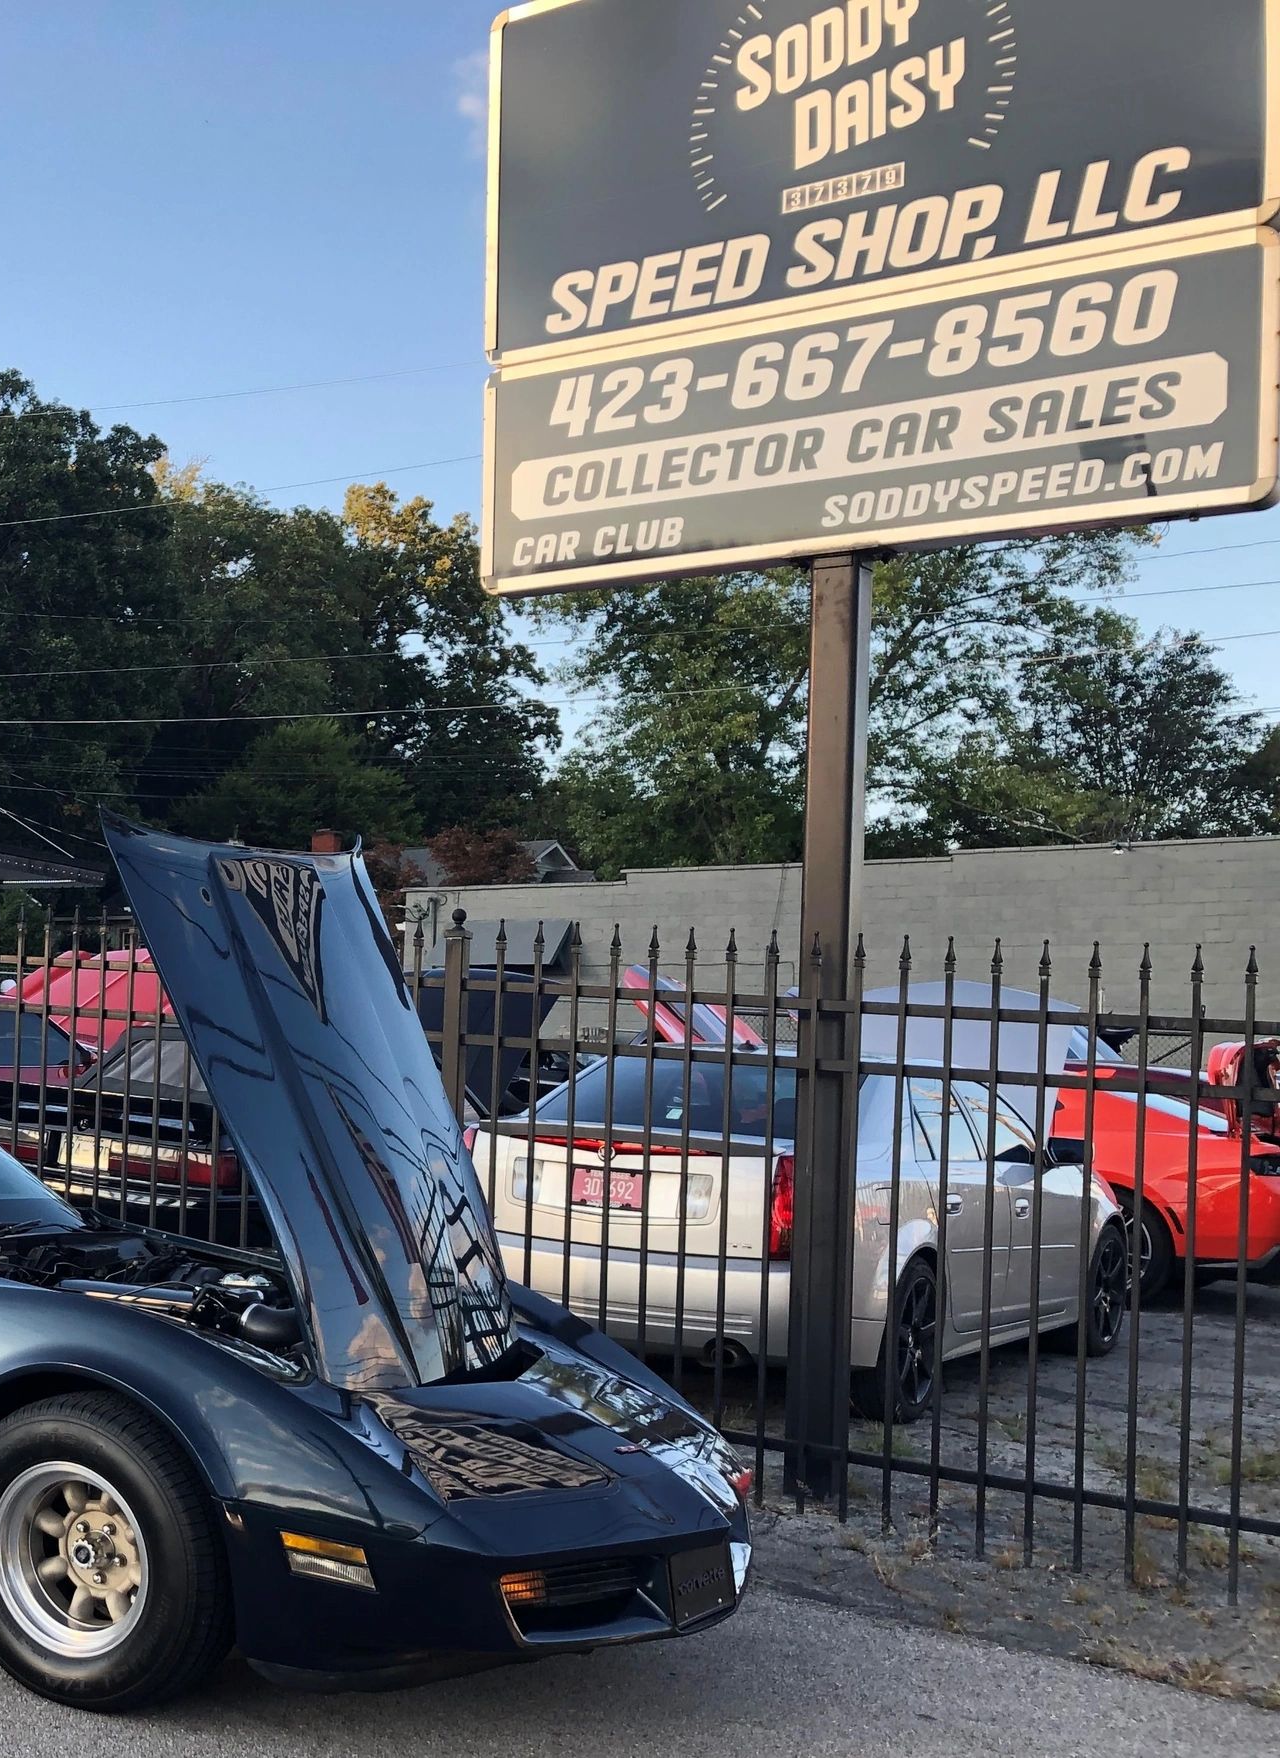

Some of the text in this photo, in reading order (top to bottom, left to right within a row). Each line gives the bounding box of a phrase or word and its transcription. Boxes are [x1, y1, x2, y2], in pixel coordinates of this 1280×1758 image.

[736, 0, 920, 111] SODDY
[794, 37, 965, 170] DAISY
[545, 146, 1191, 335] SPEED SHOP, LLC
[549, 268, 1178, 439] 423-667-8560
[542, 371, 1183, 507] COLLECTOR CAR SALES
[821, 442, 1224, 528] SODDYSPEED.COM
[513, 517, 685, 568] CAR CLUB
